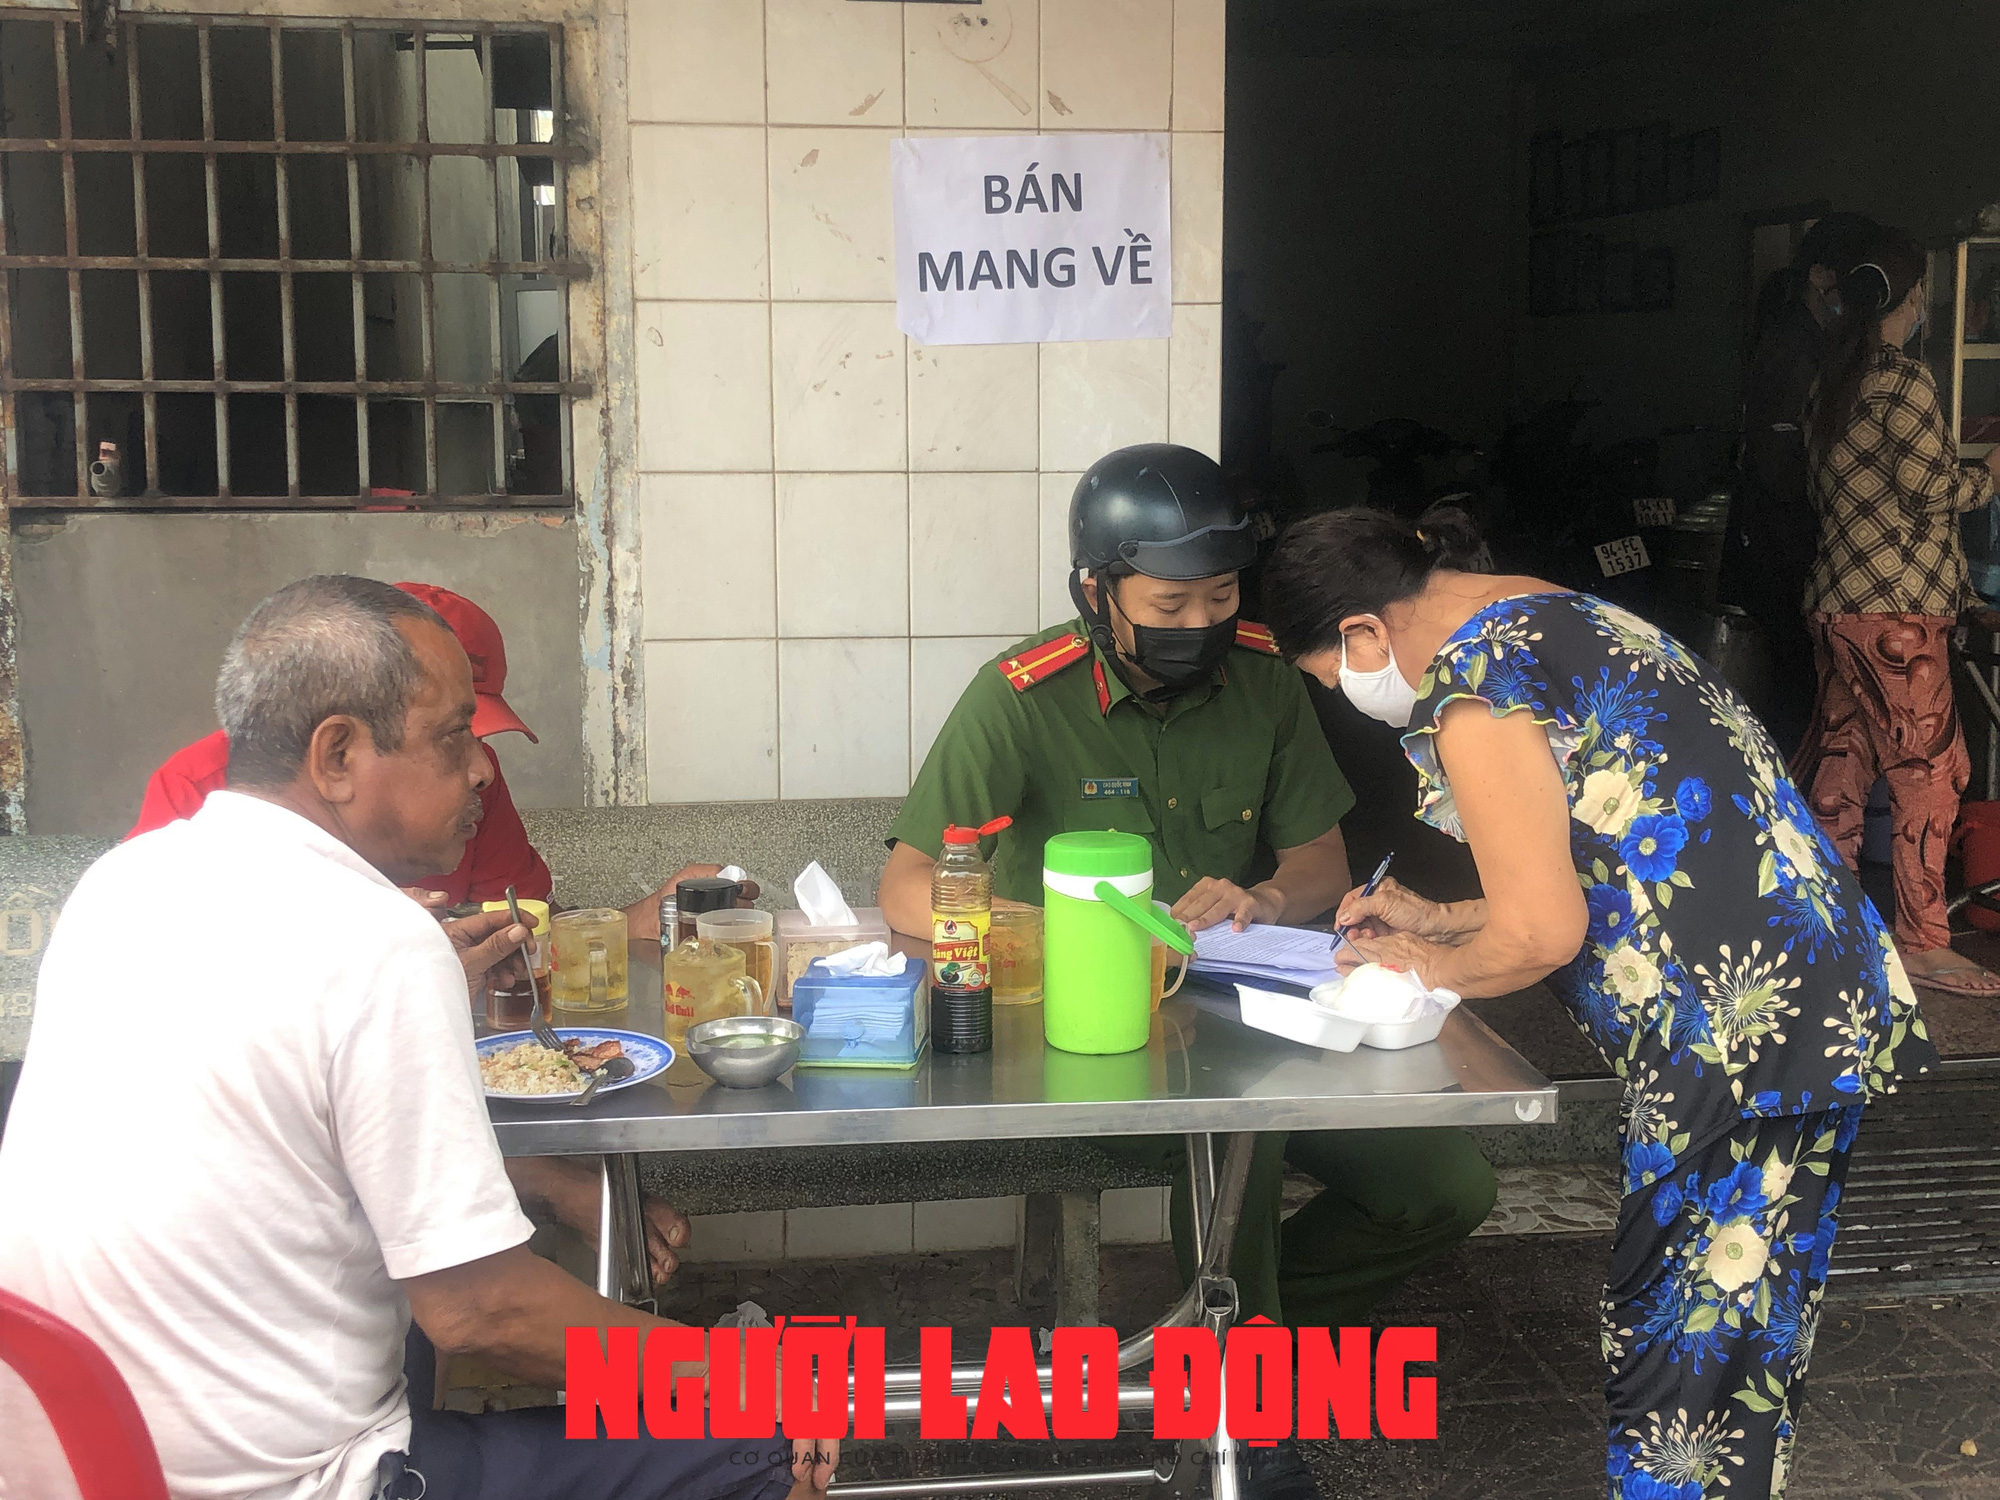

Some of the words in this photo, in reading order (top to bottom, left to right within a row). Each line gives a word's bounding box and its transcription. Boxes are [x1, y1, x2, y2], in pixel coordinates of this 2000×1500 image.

[984, 161, 1083, 215] BÁN
[917, 247, 1077, 293] MANG
[1091, 228, 1153, 286] VỀ
[1607, 552, 1641, 573] 1537
[953, 946, 979, 961] Việt
